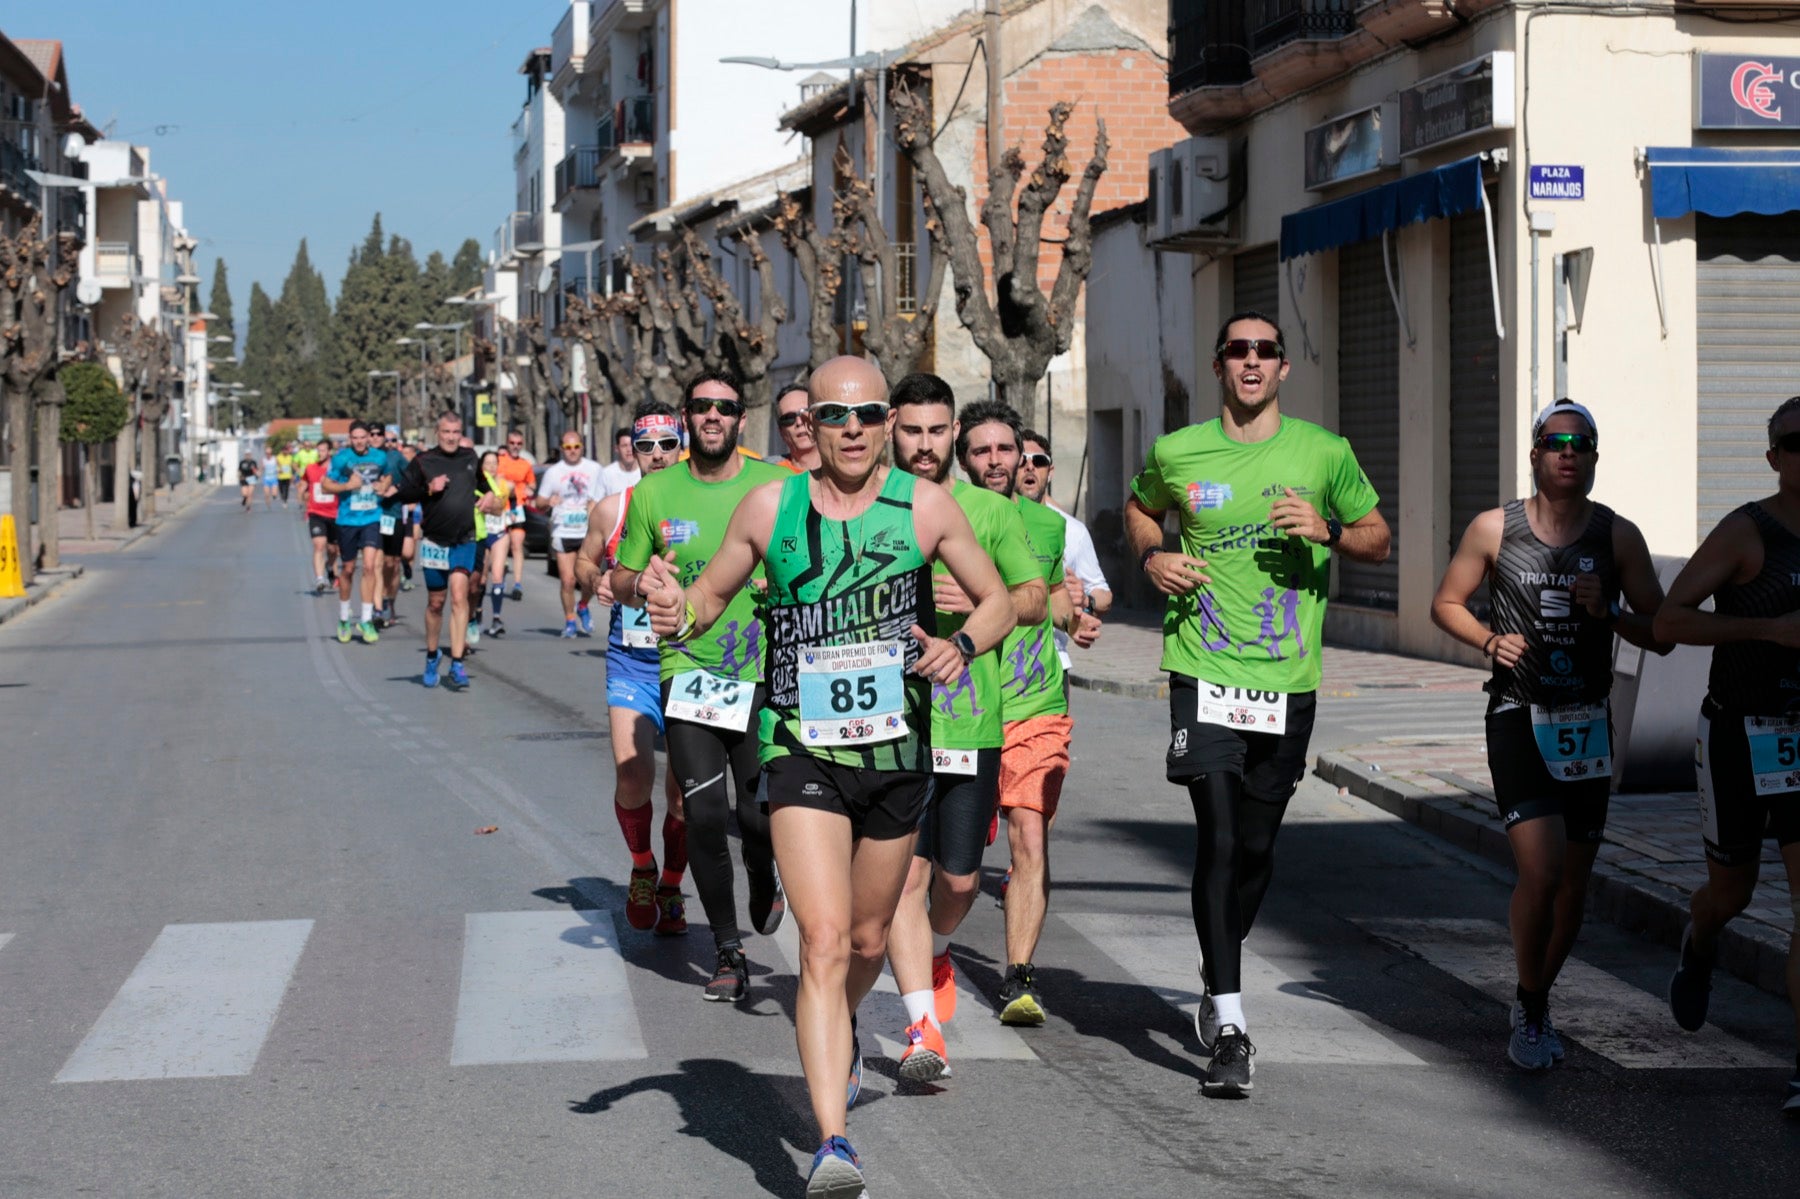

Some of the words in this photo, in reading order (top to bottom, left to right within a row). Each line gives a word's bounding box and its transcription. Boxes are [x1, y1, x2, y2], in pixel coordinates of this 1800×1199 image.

[1541, 167, 1571, 178] PLAZA
[1532, 181, 1582, 197] NARANJOS
[771, 602, 823, 645] TEAM
[826, 570, 919, 633] HALCON
[1533, 620, 1581, 632] SEAT
[822, 650, 841, 660] GRAN
[841, 646, 867, 658] PREMIO
[868, 645, 877, 656] DE
[830, 675, 878, 713] 85
[1558, 727, 1591, 756] 57
[1777, 737, 1800, 766] 5
